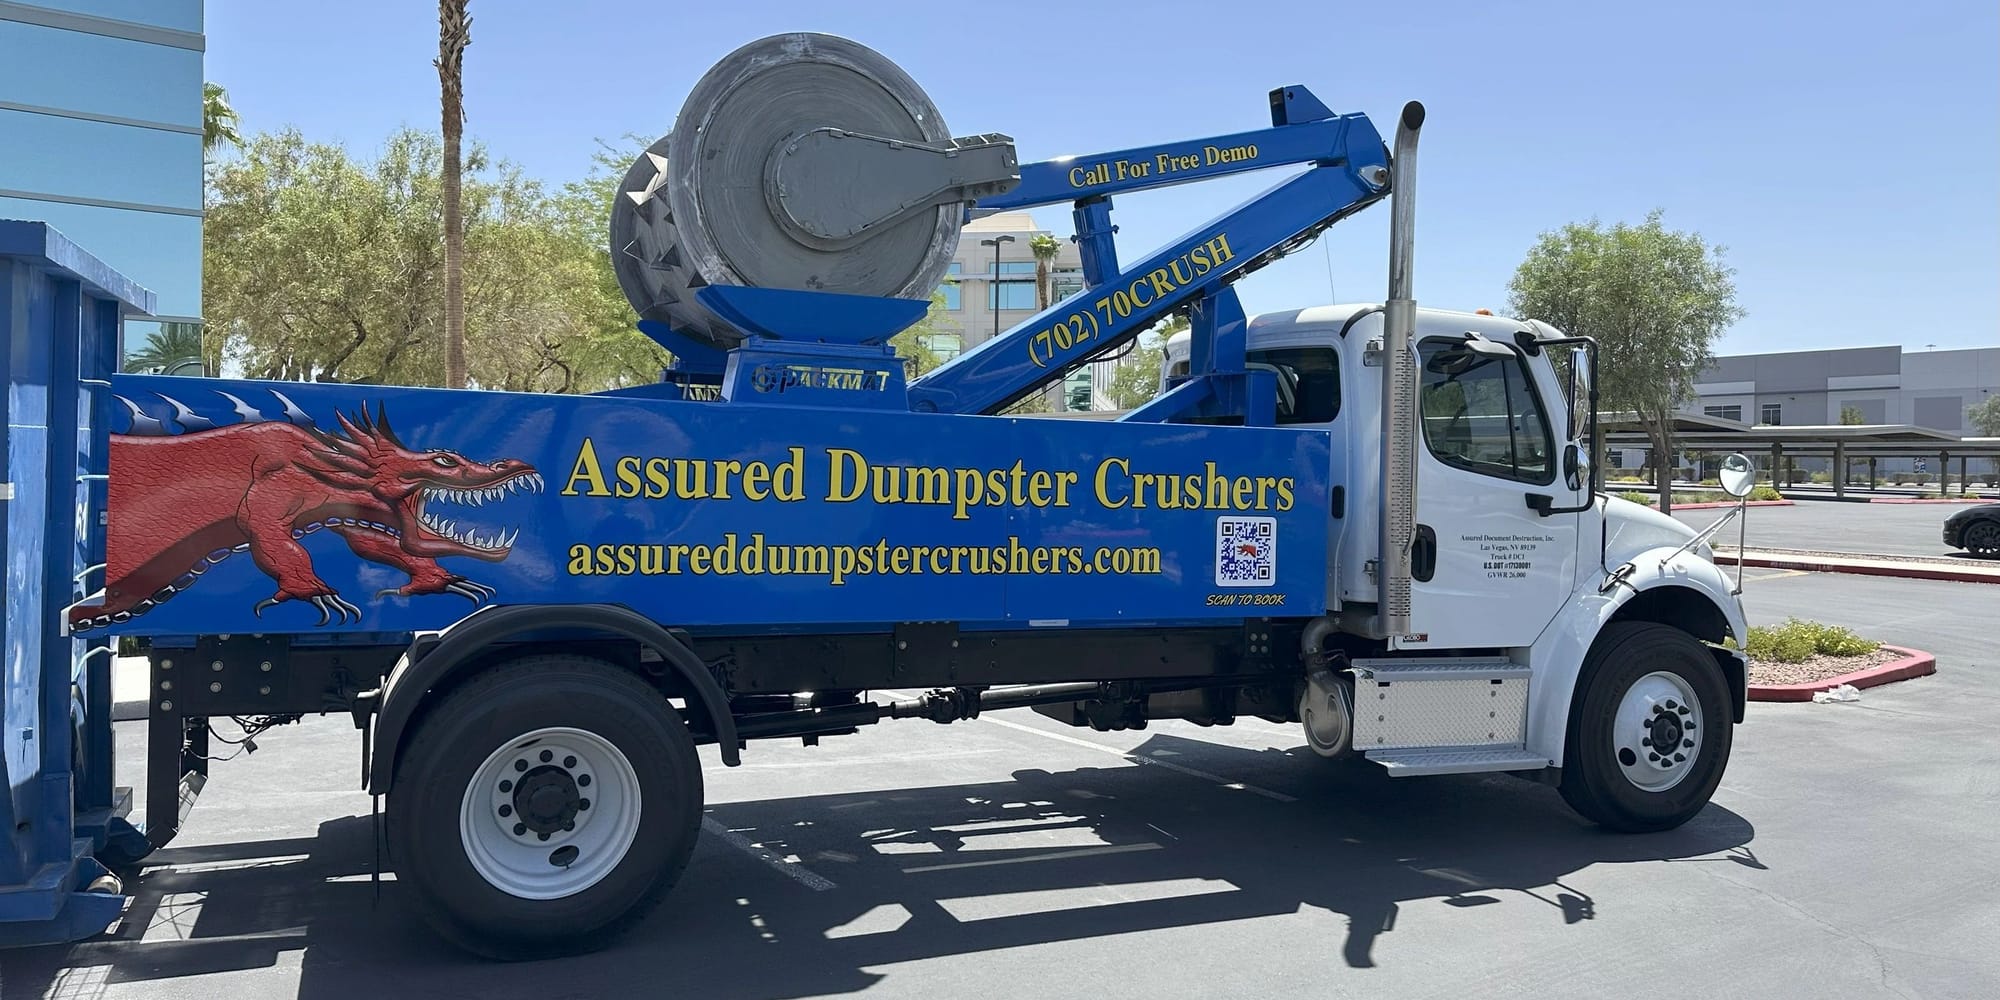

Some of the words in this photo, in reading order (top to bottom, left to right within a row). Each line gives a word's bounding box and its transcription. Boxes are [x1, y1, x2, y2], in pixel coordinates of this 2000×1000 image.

[1068, 163, 1111, 188] Call
[1115, 160, 1151, 181] For
[1155, 153, 1200, 174] Free
[1204, 144, 1258, 166] Demo
[779, 365, 891, 393] PACKMAT
[561, 437, 806, 501] Assured
[824, 447, 1079, 520] Dumpster
[1094, 457, 1296, 512] Crushers
[1461, 534, 1483, 542] Assured
[1483, 534, 1512, 542] Document
[567, 534, 1162, 585] assureddumpstercrushers.com
[1490, 553, 1507, 561] Truck
[1493, 562, 1504, 570] DOT
[1487, 571, 1508, 579] GVWR
[1206, 594, 1238, 606] SCAN
[1238, 594, 1253, 606] TO
[1254, 594, 1286, 606] BOOK
